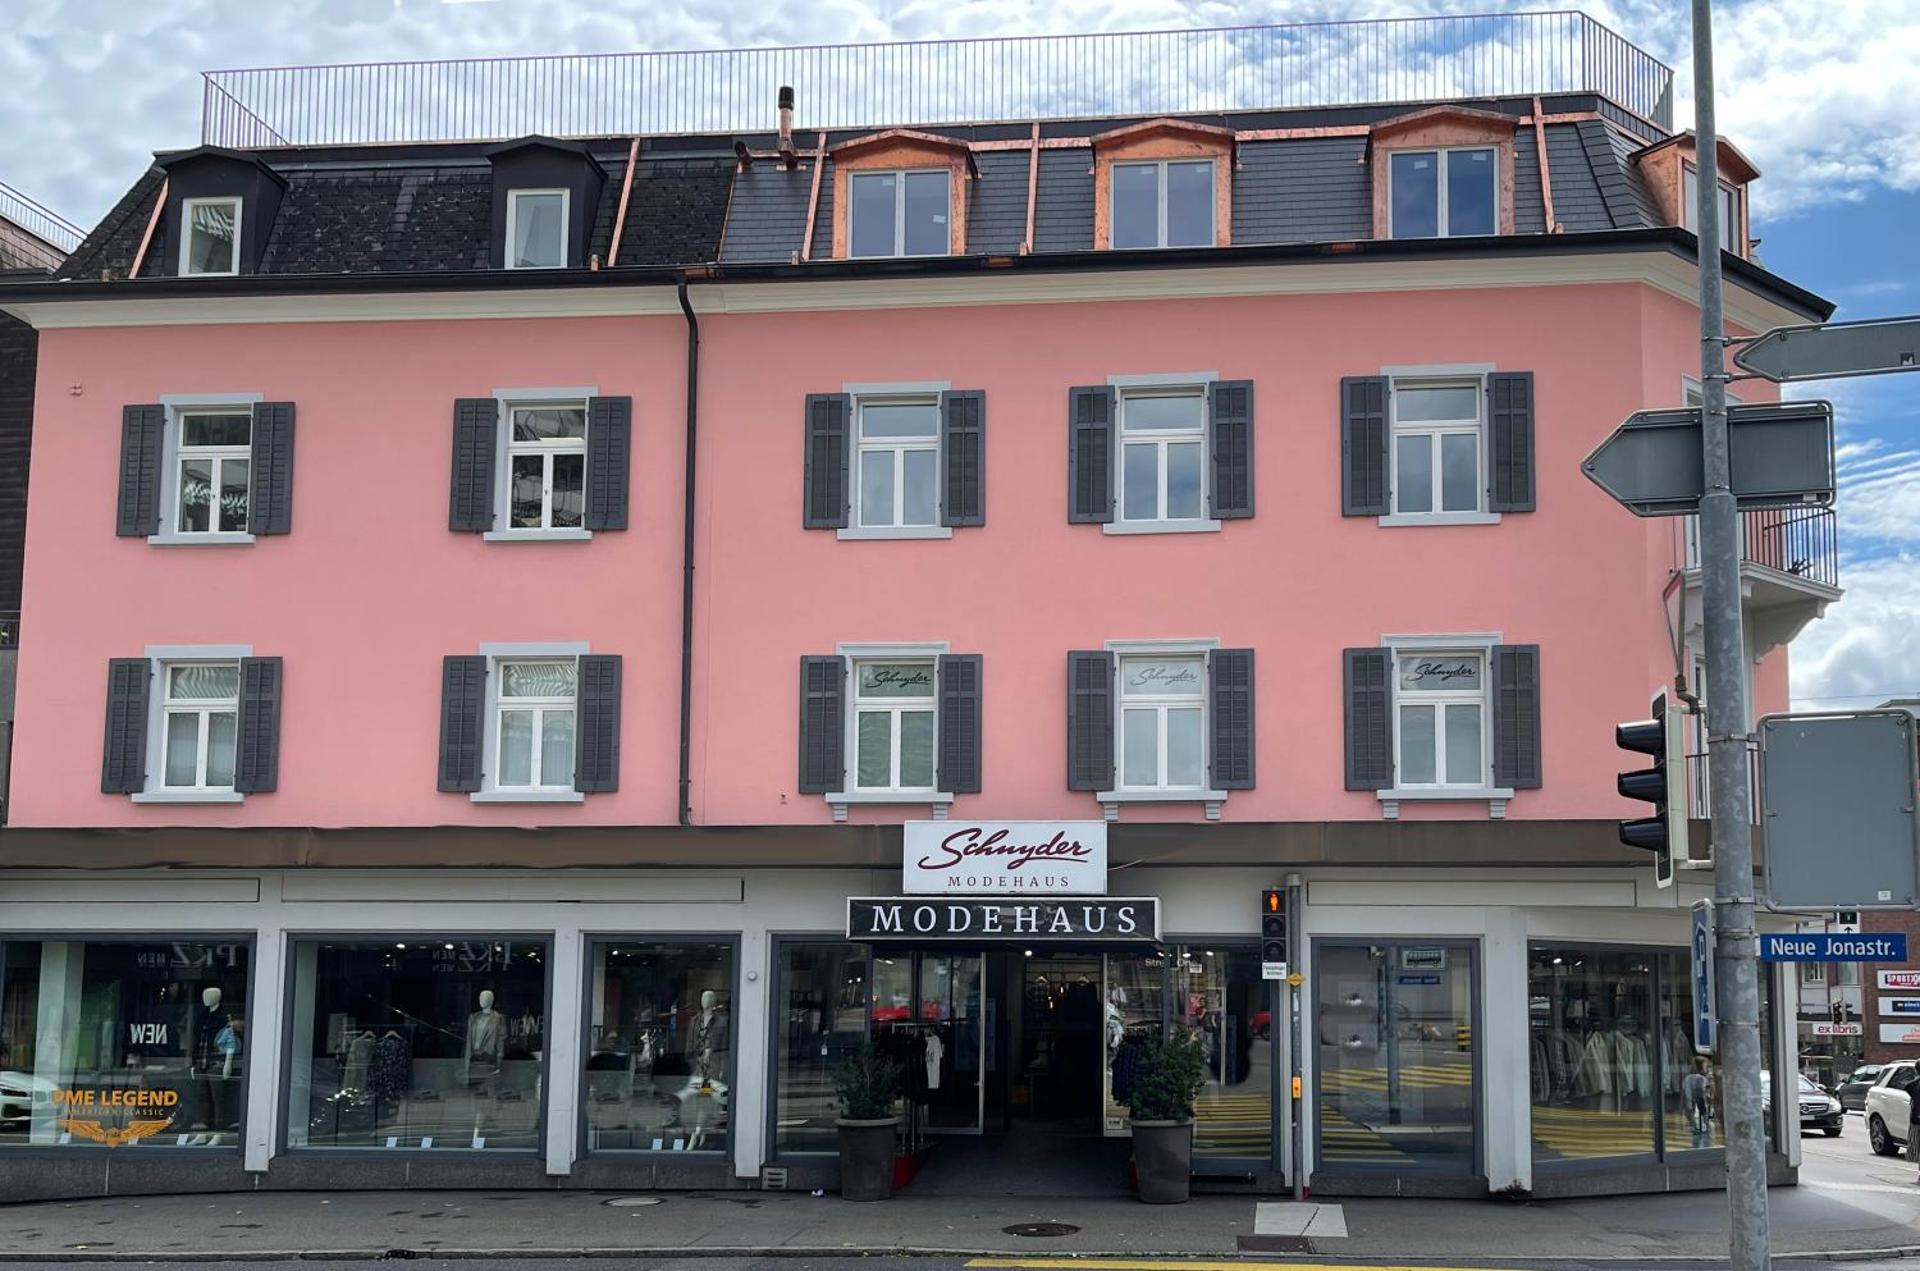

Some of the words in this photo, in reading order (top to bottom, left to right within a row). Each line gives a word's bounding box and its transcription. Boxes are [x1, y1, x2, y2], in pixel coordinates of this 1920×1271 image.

[865, 671, 931, 688] Schnyder
[1129, 667, 1198, 686] Schnyder
[1406, 663, 1475, 681] Schnyder
[917, 827, 1092, 870] Schnyder
[948, 876, 1069, 887] MODEHAUS
[870, 905, 1136, 933] MODEHAUS
[1771, 938, 1816, 955] Neue
[1825, 938, 1896, 955] Jonastr.
[1818, 1025, 1831, 1034] ex
[101, 1089, 179, 1107] LEGEND
